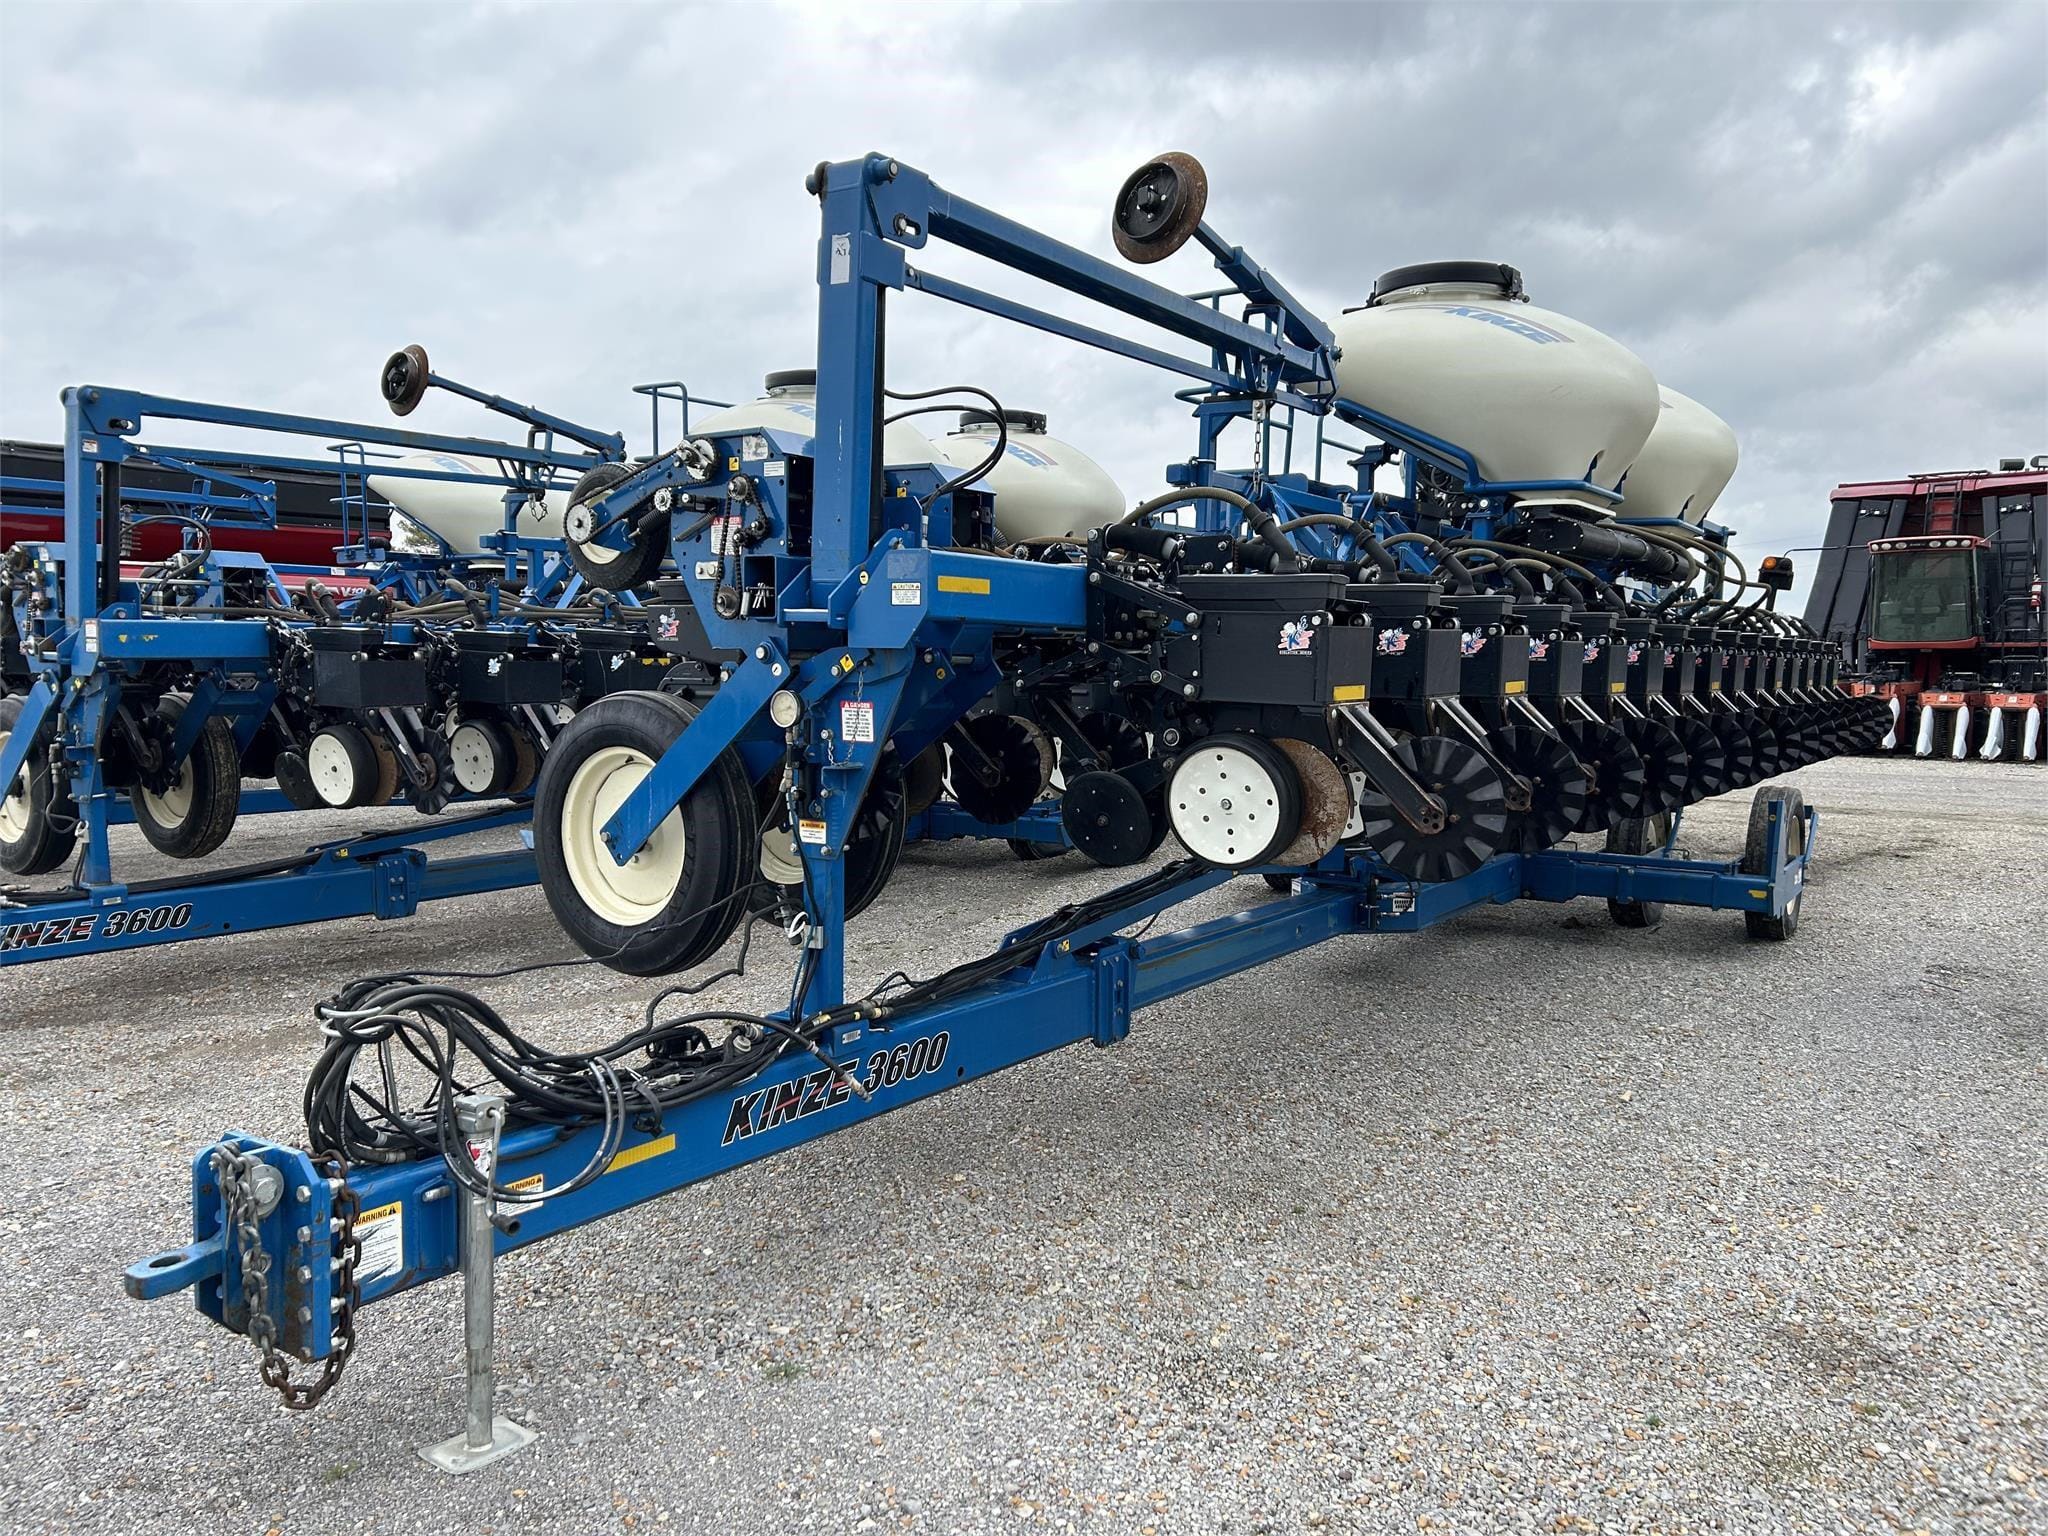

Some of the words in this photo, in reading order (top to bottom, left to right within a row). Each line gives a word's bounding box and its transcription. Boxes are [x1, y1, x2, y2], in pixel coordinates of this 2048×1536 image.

[1443, 307, 1554, 344] KINZE
[0, 914, 99, 951] INZE
[102, 903, 193, 939] 3600
[721, 1058, 859, 1147] KINZE
[864, 1031, 950, 1095] 3600
[511, 1178, 536, 1190] ARNING
